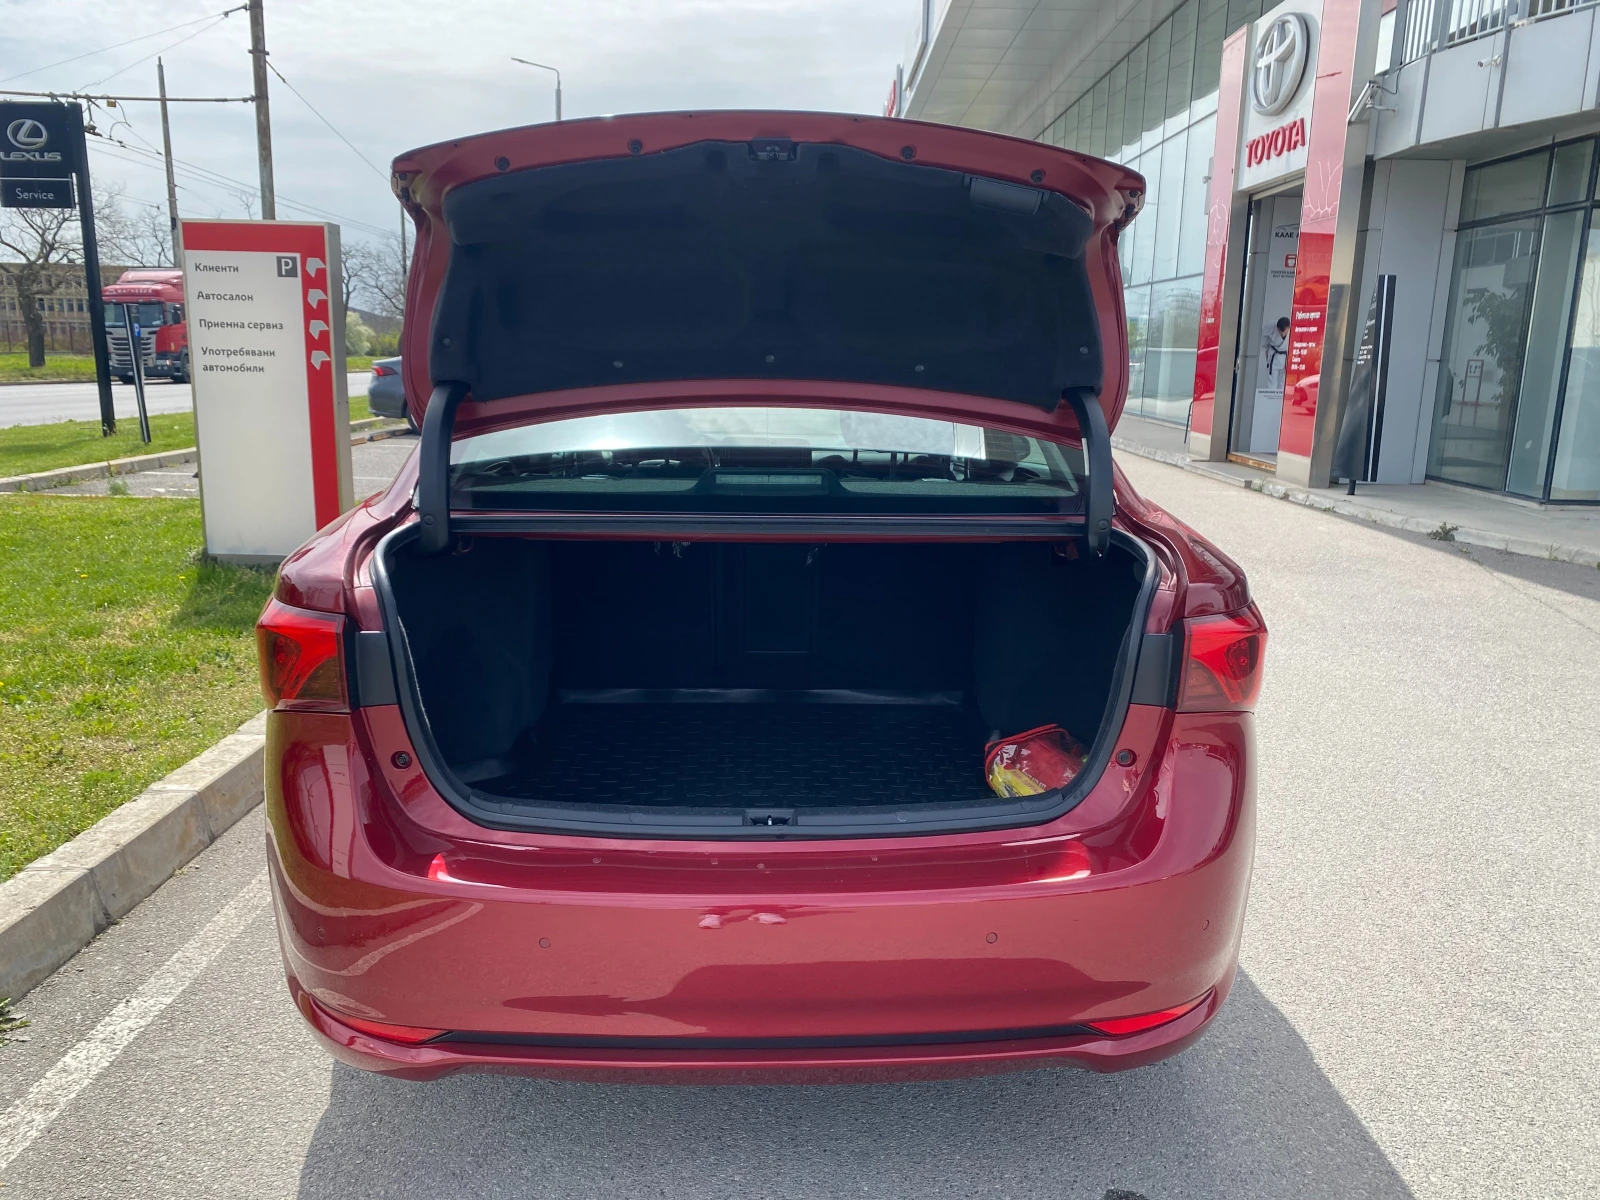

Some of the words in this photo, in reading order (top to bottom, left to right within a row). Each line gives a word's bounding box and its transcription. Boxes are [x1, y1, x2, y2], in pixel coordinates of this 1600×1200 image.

[1246, 117, 1306, 168] TOYOTA
[0, 151, 62, 161] LEXUS
[15, 187, 55, 200] Service
[194, 262, 240, 273] Клиенти
[281, 258, 293, 276] P
[196, 290, 254, 302] Автосалон
[199, 318, 245, 330] Приемна
[247, 321, 284, 332] сервиз
[201, 346, 276, 358] Употребявани
[202, 363, 265, 373] автомобили
